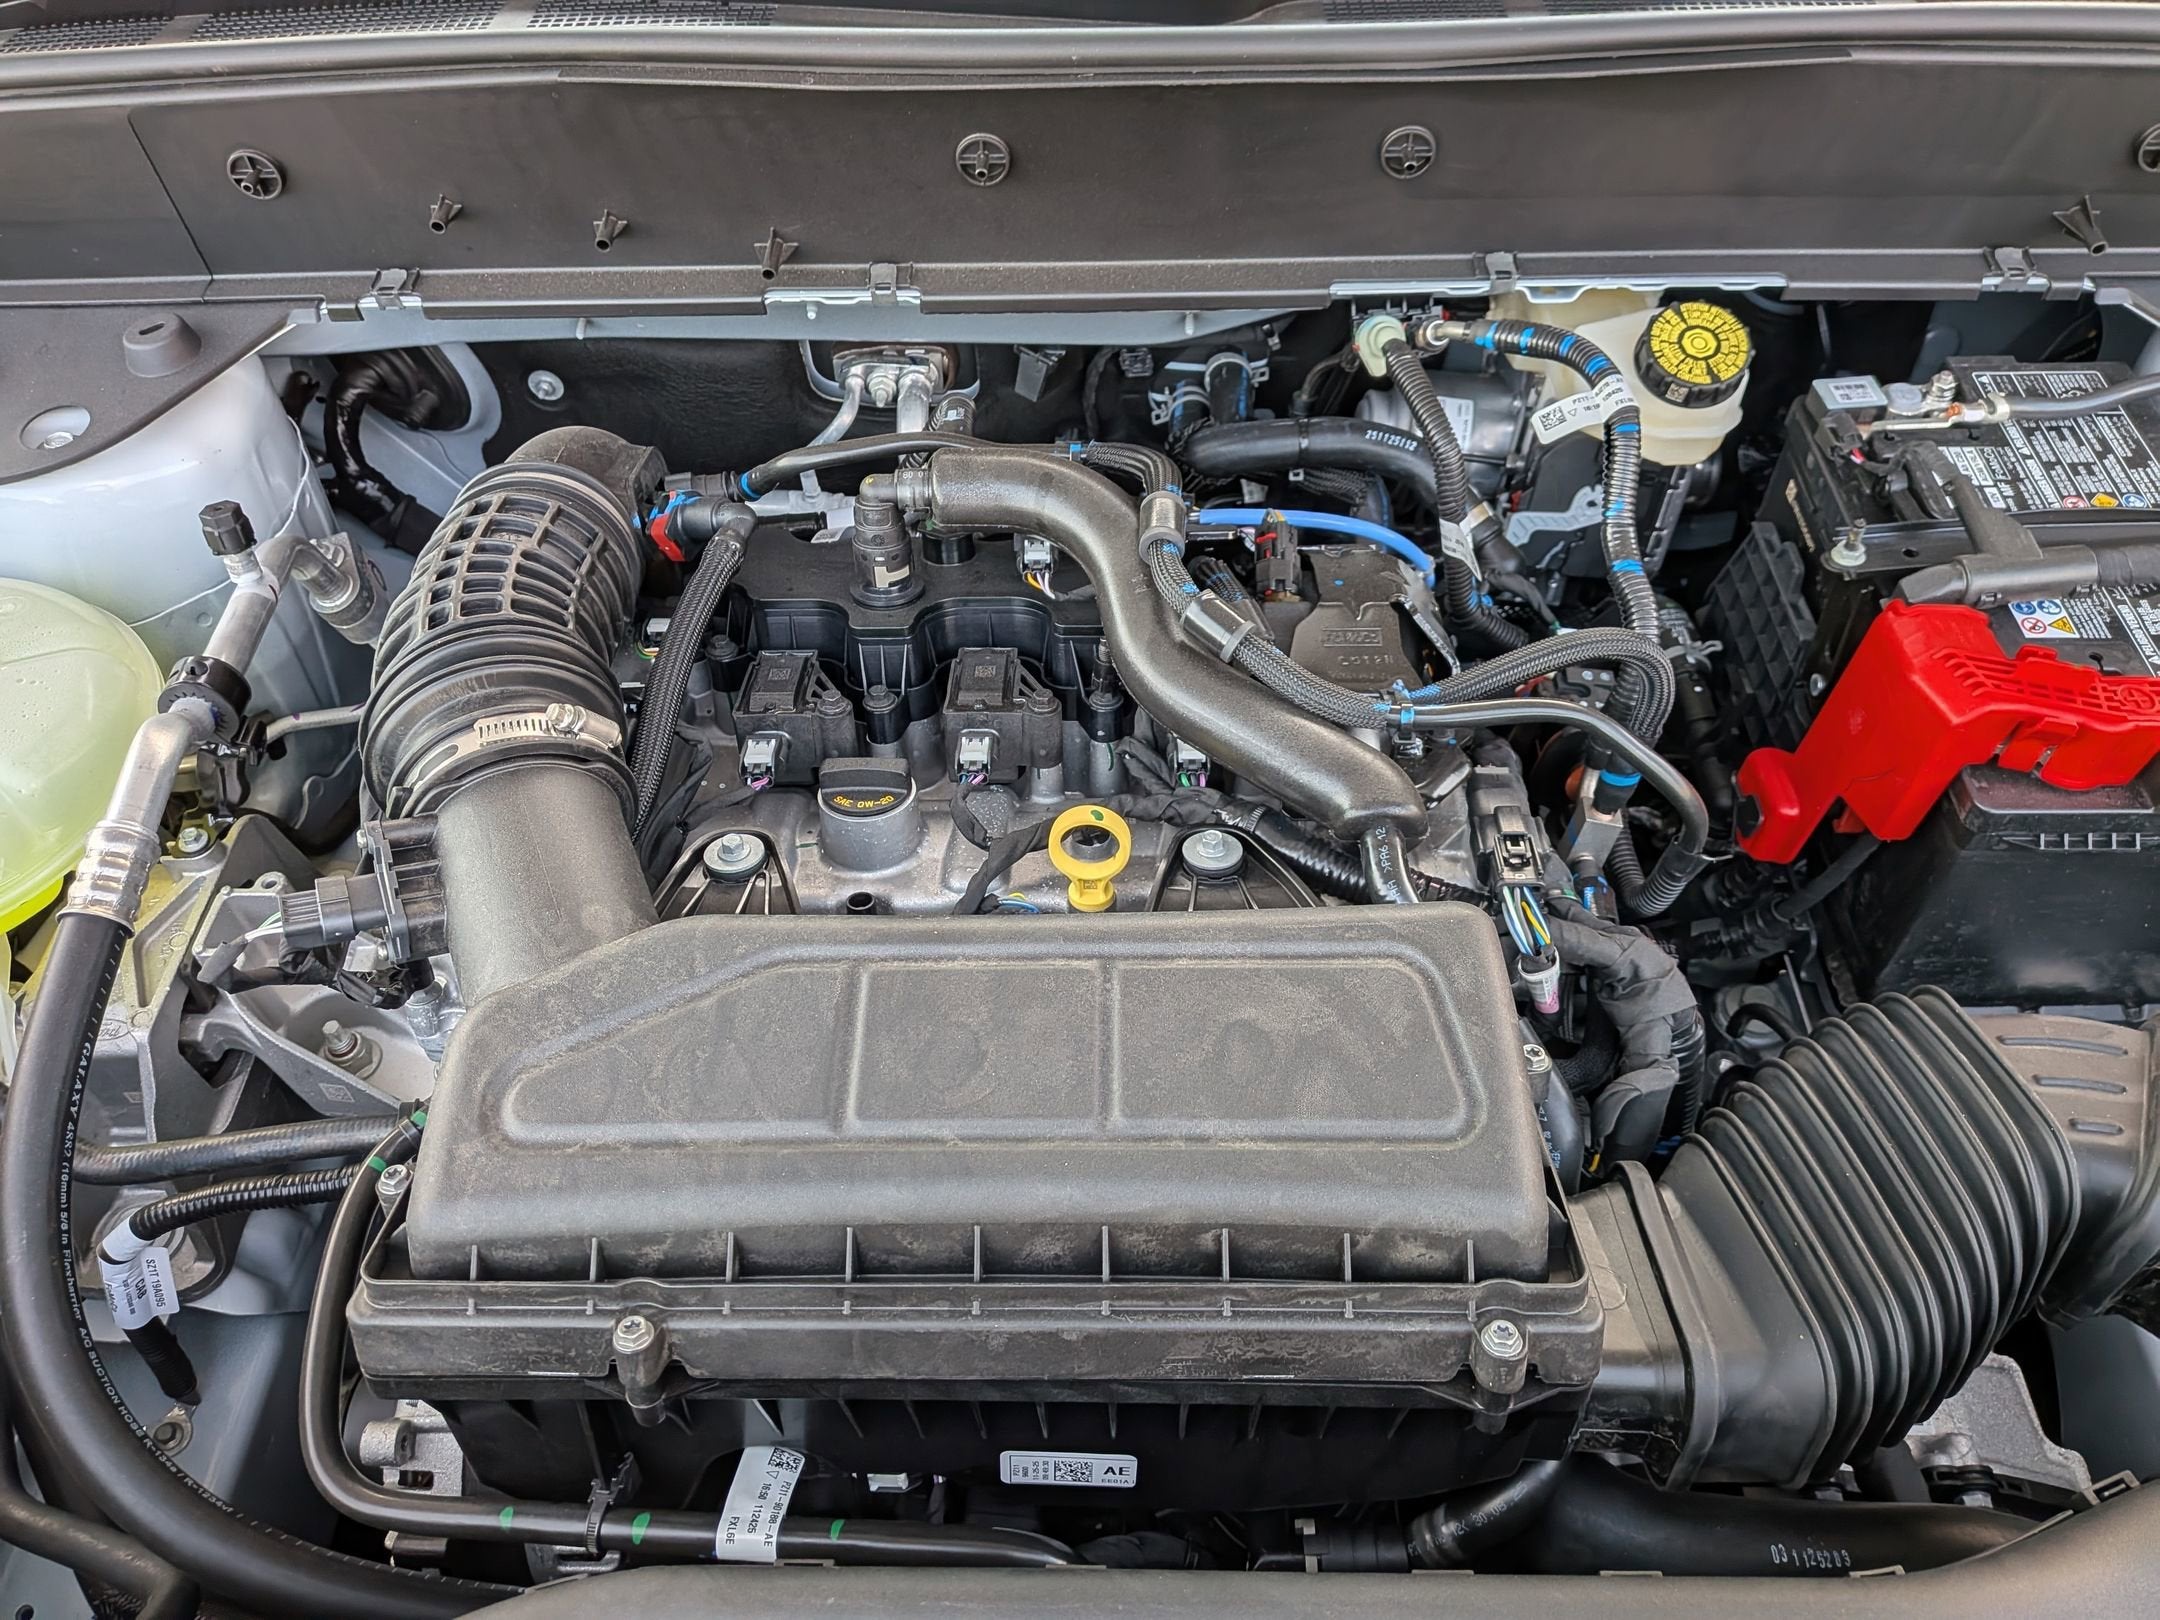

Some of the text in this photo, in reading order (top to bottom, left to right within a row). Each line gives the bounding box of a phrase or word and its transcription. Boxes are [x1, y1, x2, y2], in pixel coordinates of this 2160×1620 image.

[834, 795, 895, 808] SAE 0W-20
[60, 1162, 69, 1210] (16mm)
[60, 1211, 69, 1231] 5/8
[134, 1278, 148, 1300] CAB
[151, 1277, 166, 1309] 19A095
[79, 1327, 93, 1348] A/C
[88, 1351, 121, 1404] SUCTION
[118, 1406, 146, 1437] HOSE
[143, 1438, 178, 1473] R-134a
[1103, 1466, 1131, 1476] AE
[746, 1483, 772, 1534] 16:50 112425
[726, 1516, 740, 1545] FXL6E
